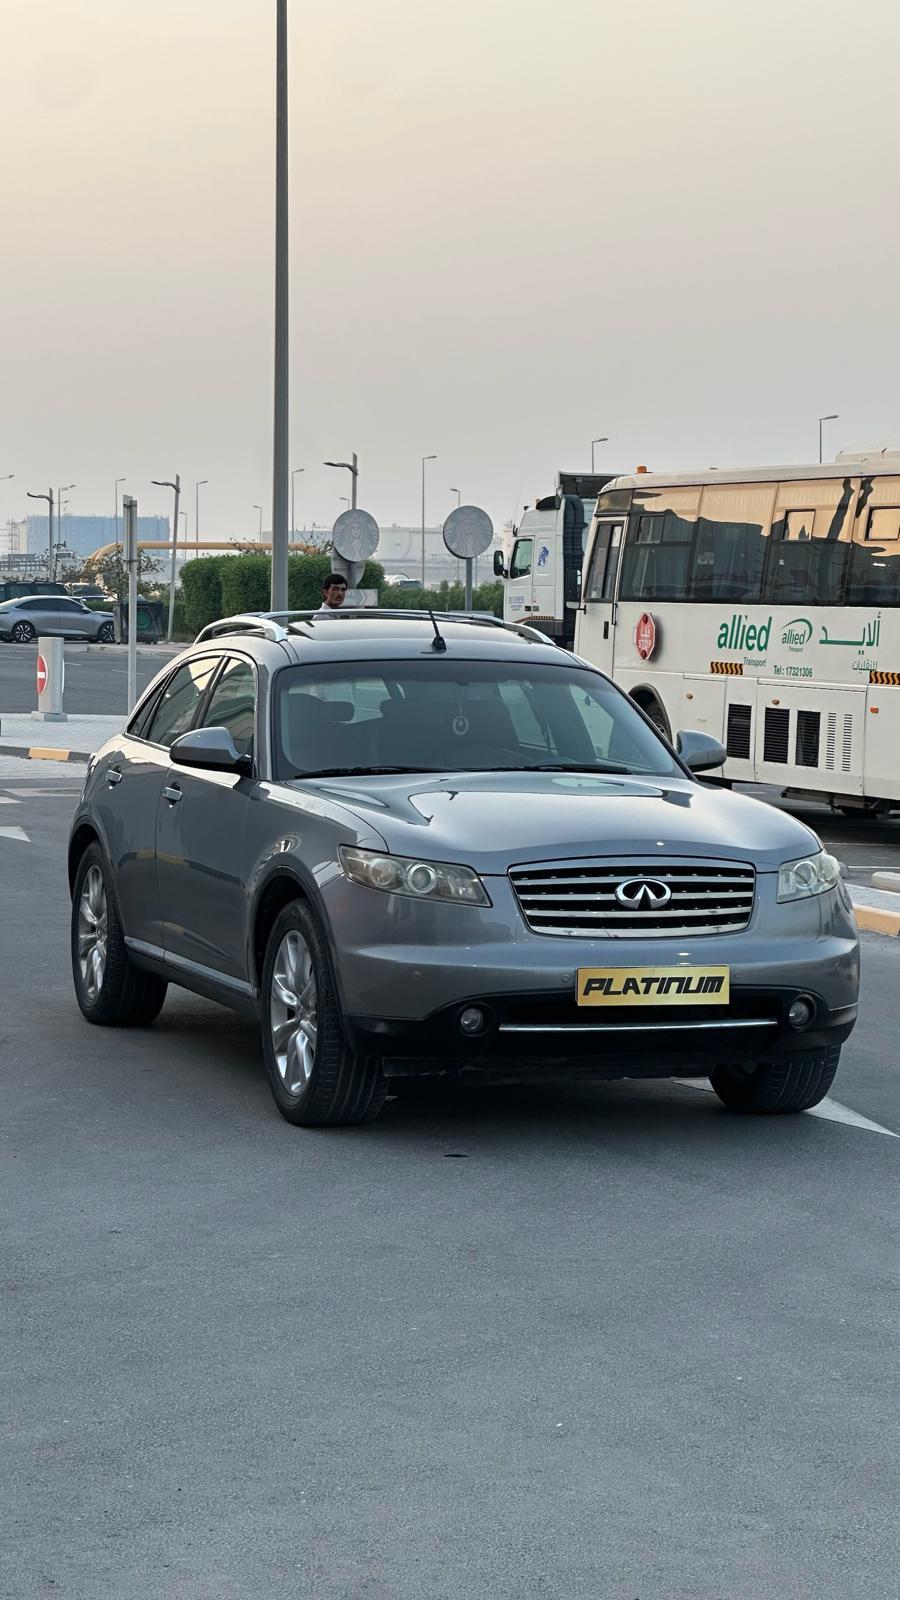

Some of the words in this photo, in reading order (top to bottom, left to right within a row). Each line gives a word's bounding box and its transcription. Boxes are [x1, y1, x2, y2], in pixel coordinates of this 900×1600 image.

[717, 614, 773, 651] allied
[781, 629, 806, 645] allied
[638, 639, 652, 649] STOP
[743, 657, 766, 668] Transport
[786, 666, 813, 678] 17321306
[583, 976, 725, 996] PLATINUM
